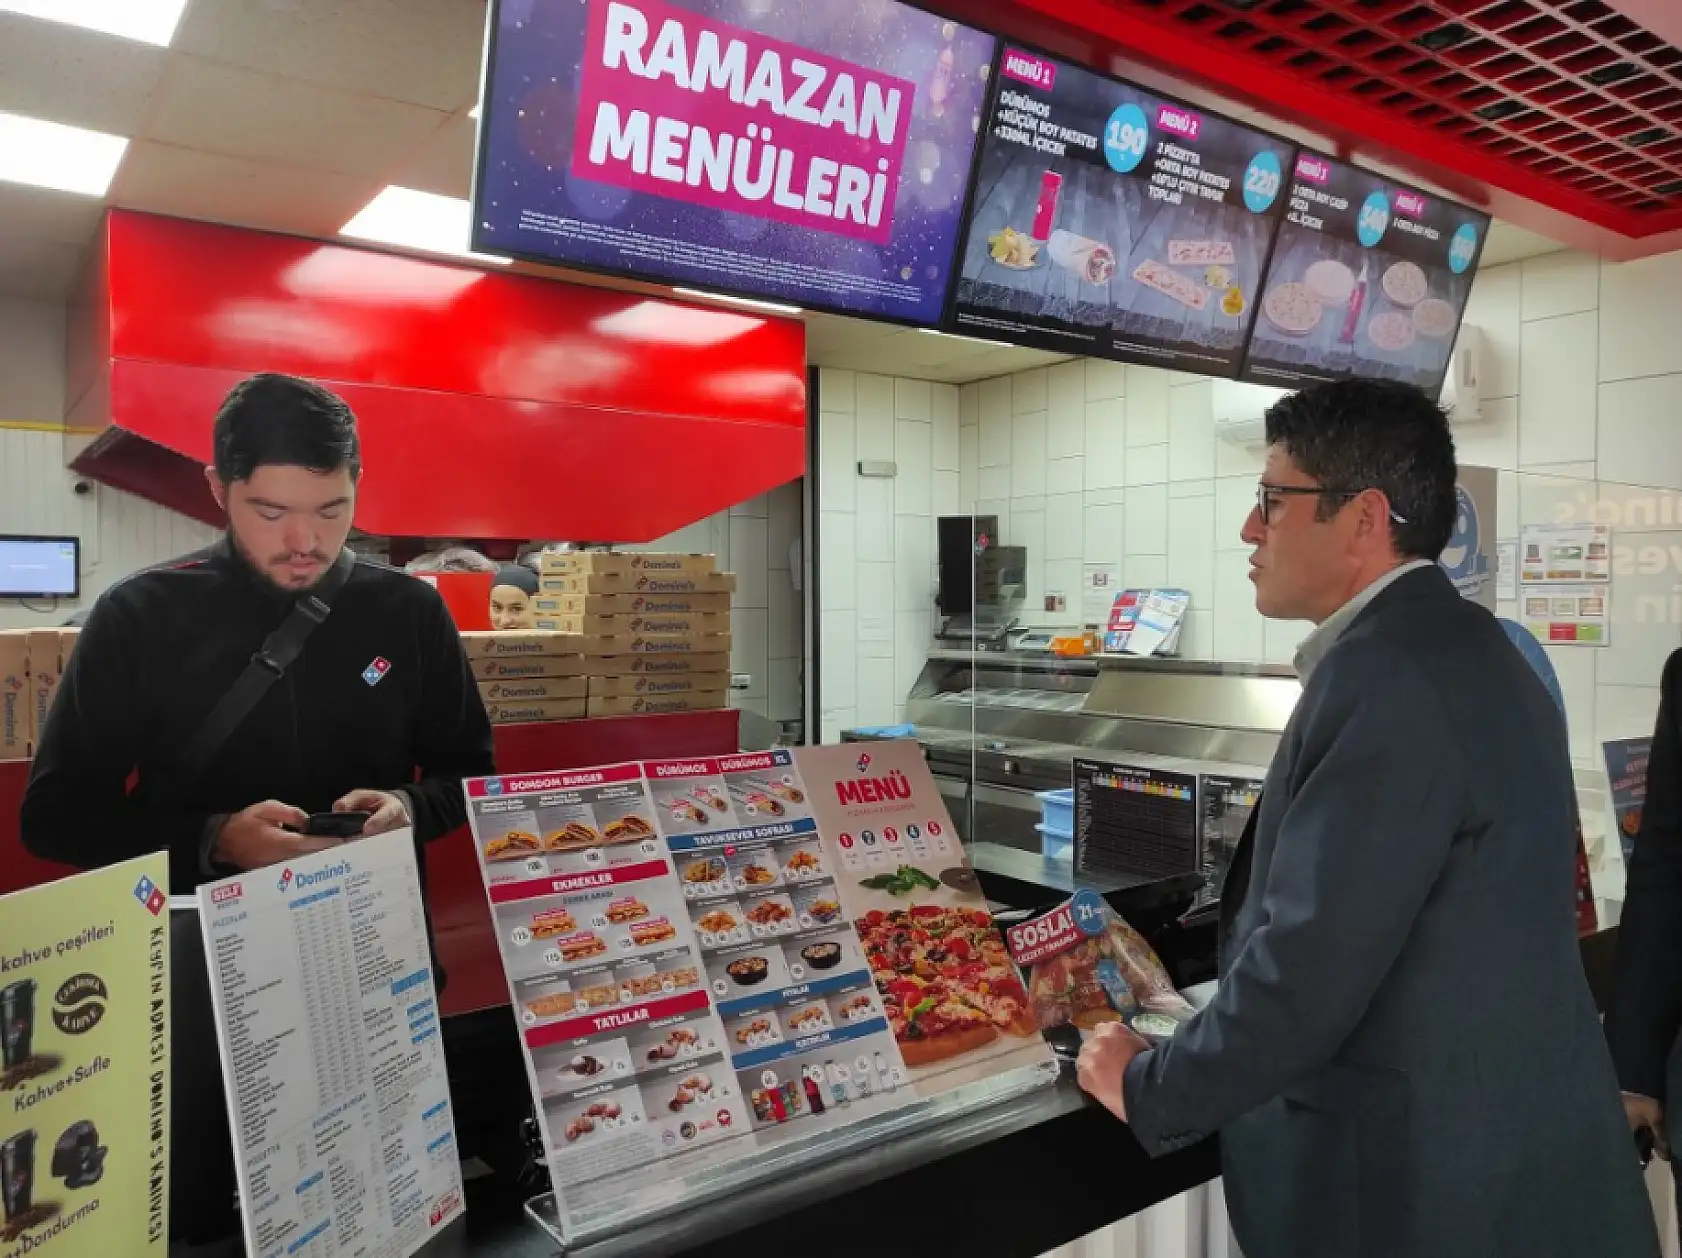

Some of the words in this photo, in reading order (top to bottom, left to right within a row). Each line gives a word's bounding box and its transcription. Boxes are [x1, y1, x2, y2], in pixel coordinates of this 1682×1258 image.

[603, 2, 901, 144] RAMAZAN
[1007, 56, 1042, 81] MENÜ
[1043, 69, 1050, 84] 1
[1107, 120, 1144, 153] 190
[1159, 110, 1191, 133] MENÜ
[589, 101, 889, 228] MENÜLERİ
[1247, 166, 1280, 197] 220
[834, 769, 912, 806] MENÜ
[295, 859, 351, 889] Domino's
[2, 946, 52, 973] kahve
[55, 919, 115, 958] çeşitleri
[1012, 908, 1074, 951] SOSLA!
[593, 1008, 649, 1030] TATLILAR
